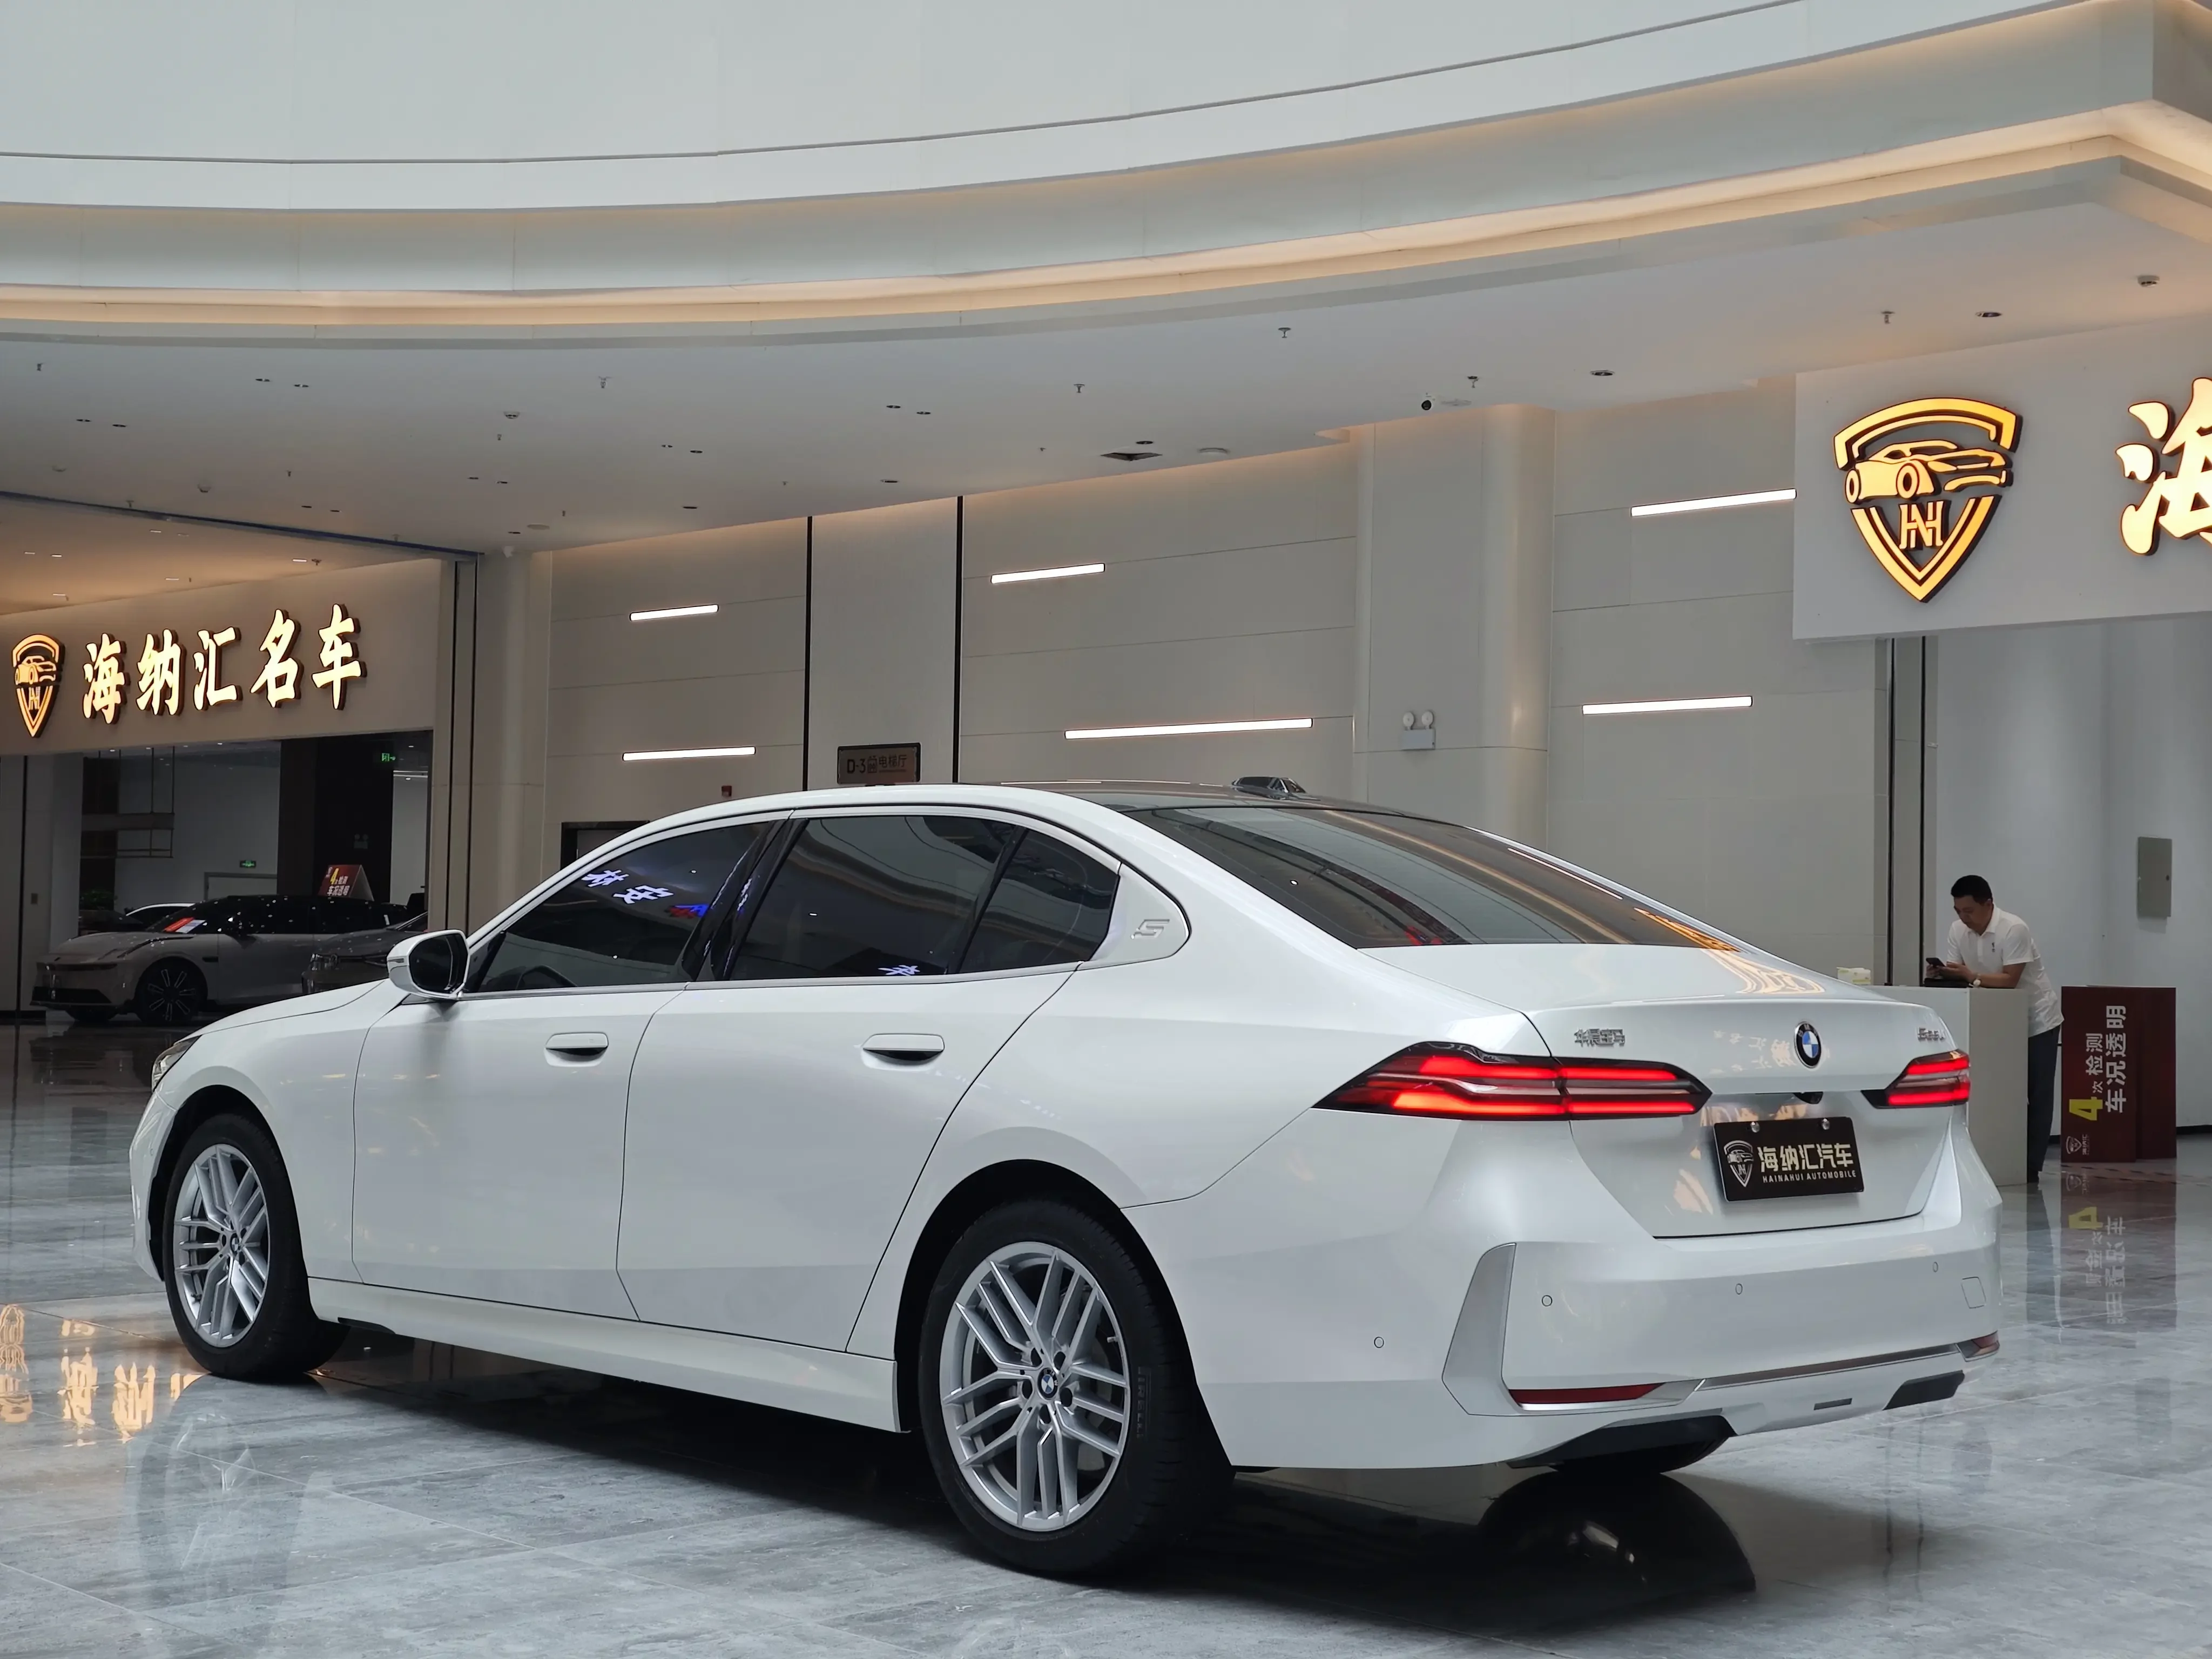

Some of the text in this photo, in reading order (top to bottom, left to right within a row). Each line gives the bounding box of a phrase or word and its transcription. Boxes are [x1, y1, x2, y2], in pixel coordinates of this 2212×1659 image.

[83, 603, 364, 724] 海纳汇名车
[847, 759, 866, 773] D-3
[879, 754, 907, 768] 电梯厅
[1574, 1028, 1626, 1048] 华晨宝马
[2105, 1005, 2127, 1114] 车况透明
[2069, 1033, 2103, 1121] 4次检测
[1757, 1142, 1854, 1172] 海纳汇汽车
[1762, 1169, 1857, 1183] HAINAHUI AUTOMOBILE
